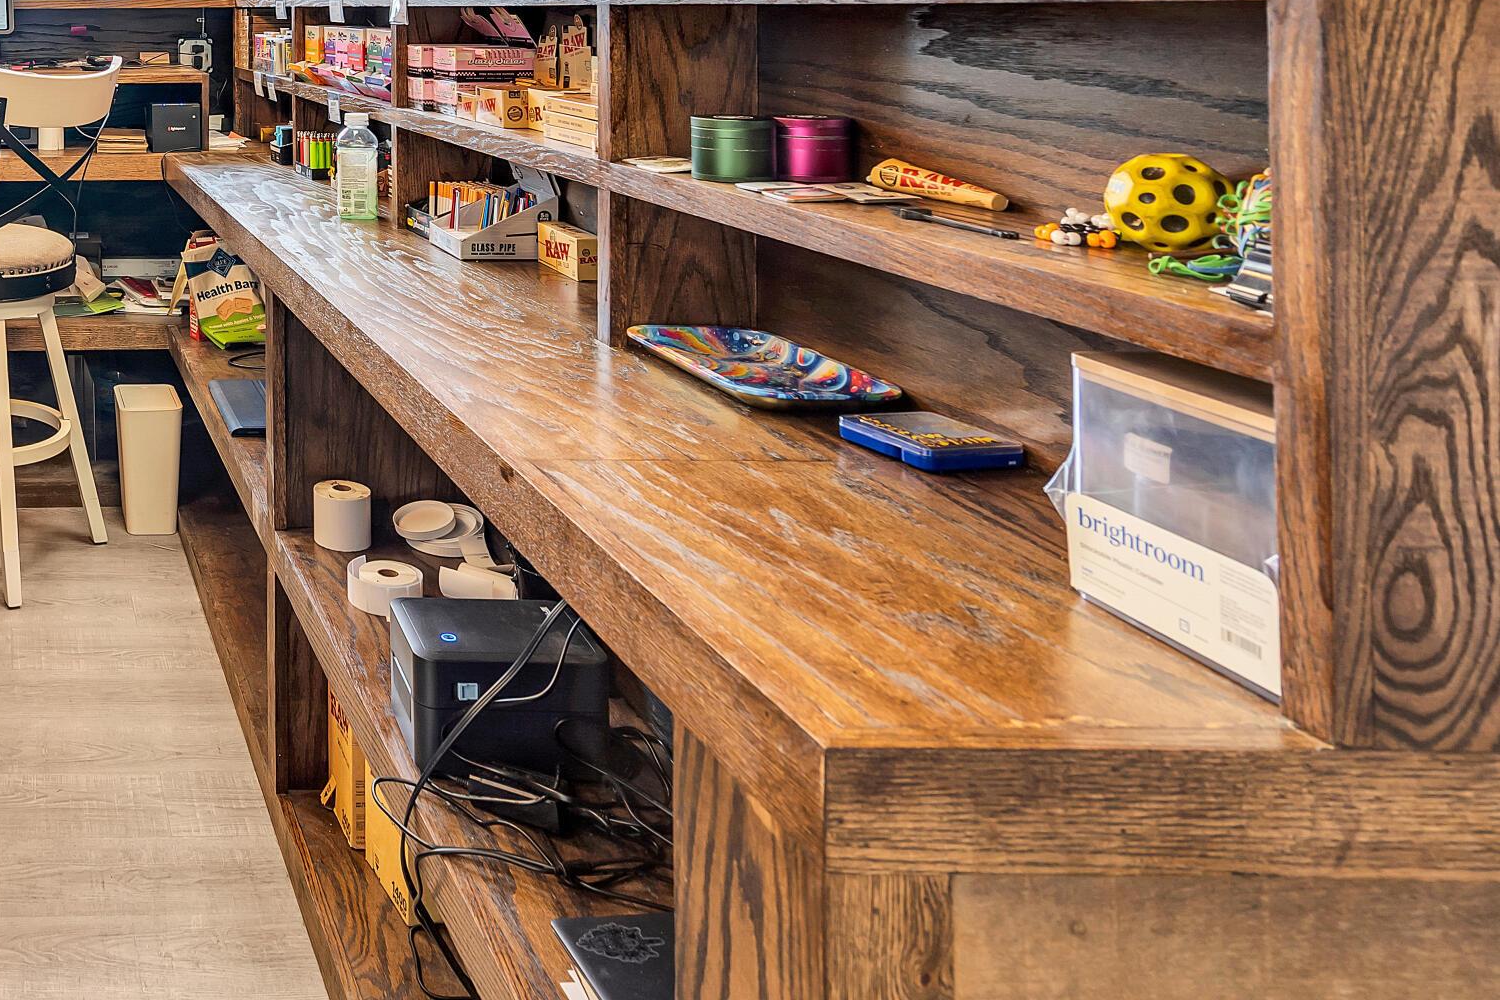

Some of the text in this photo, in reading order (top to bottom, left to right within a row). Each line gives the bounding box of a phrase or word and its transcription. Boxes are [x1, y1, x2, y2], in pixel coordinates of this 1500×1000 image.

[471, 243, 516, 252] GLASS PIPE
[545, 239, 570, 261] RAW
[197, 282, 234, 302] Health
[1078, 507, 1205, 582] brightroom
